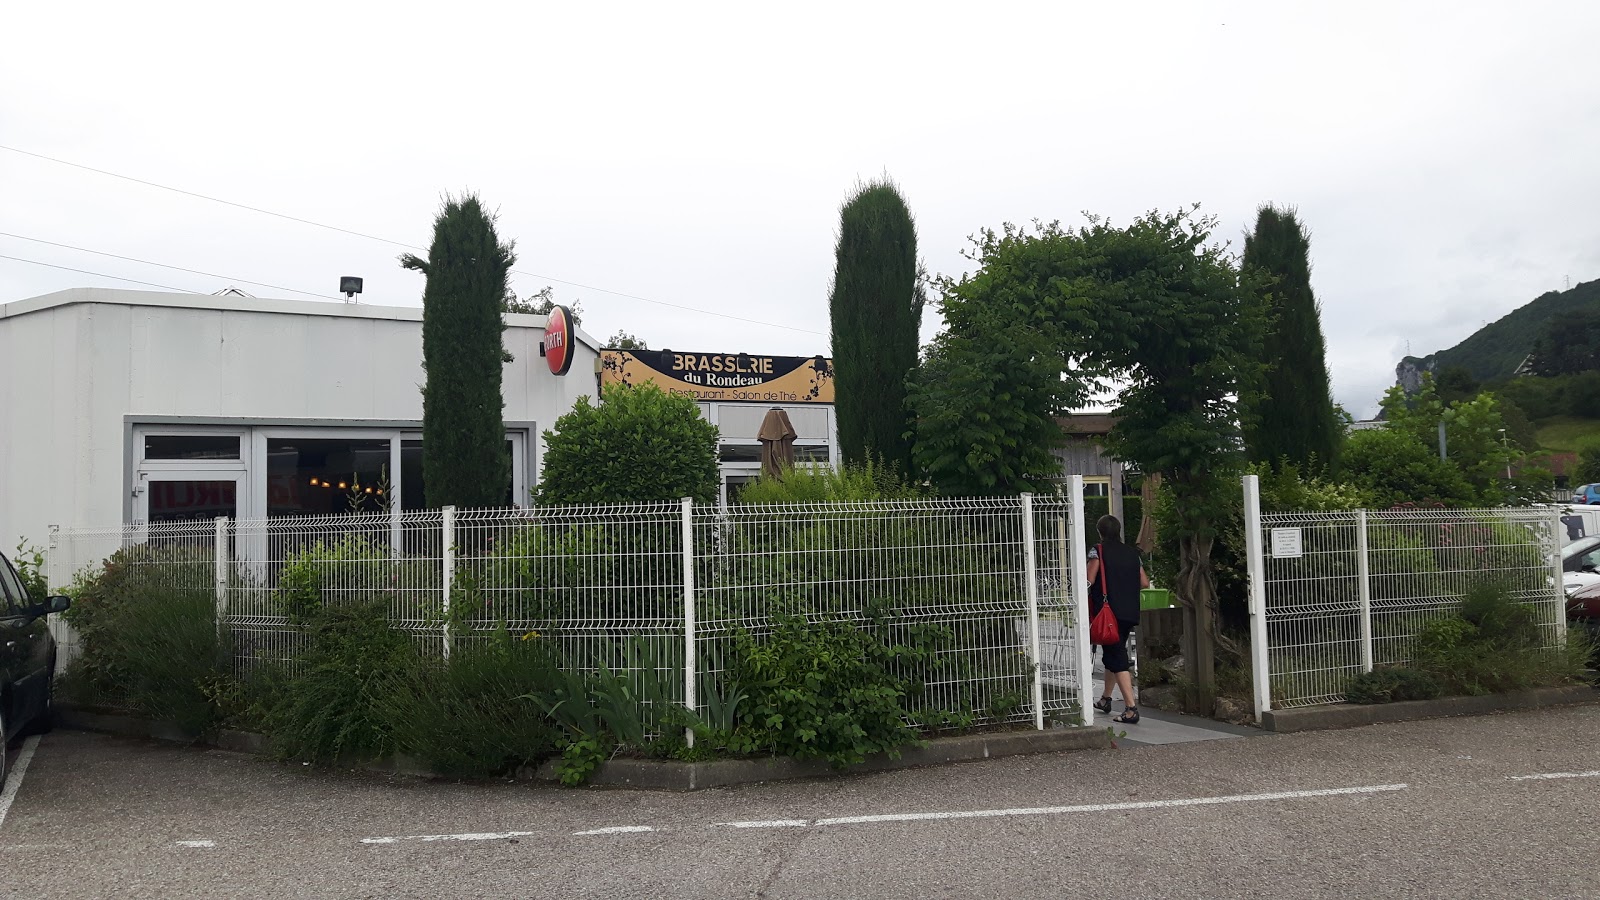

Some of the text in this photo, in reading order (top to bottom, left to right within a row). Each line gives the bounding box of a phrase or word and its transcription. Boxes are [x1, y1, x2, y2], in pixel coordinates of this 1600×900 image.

[684, 372, 763, 386] du Rondeau
[732, 389, 761, 400] Salon
[763, 391, 778, 400] de
[780, 391, 797, 401] Thé
